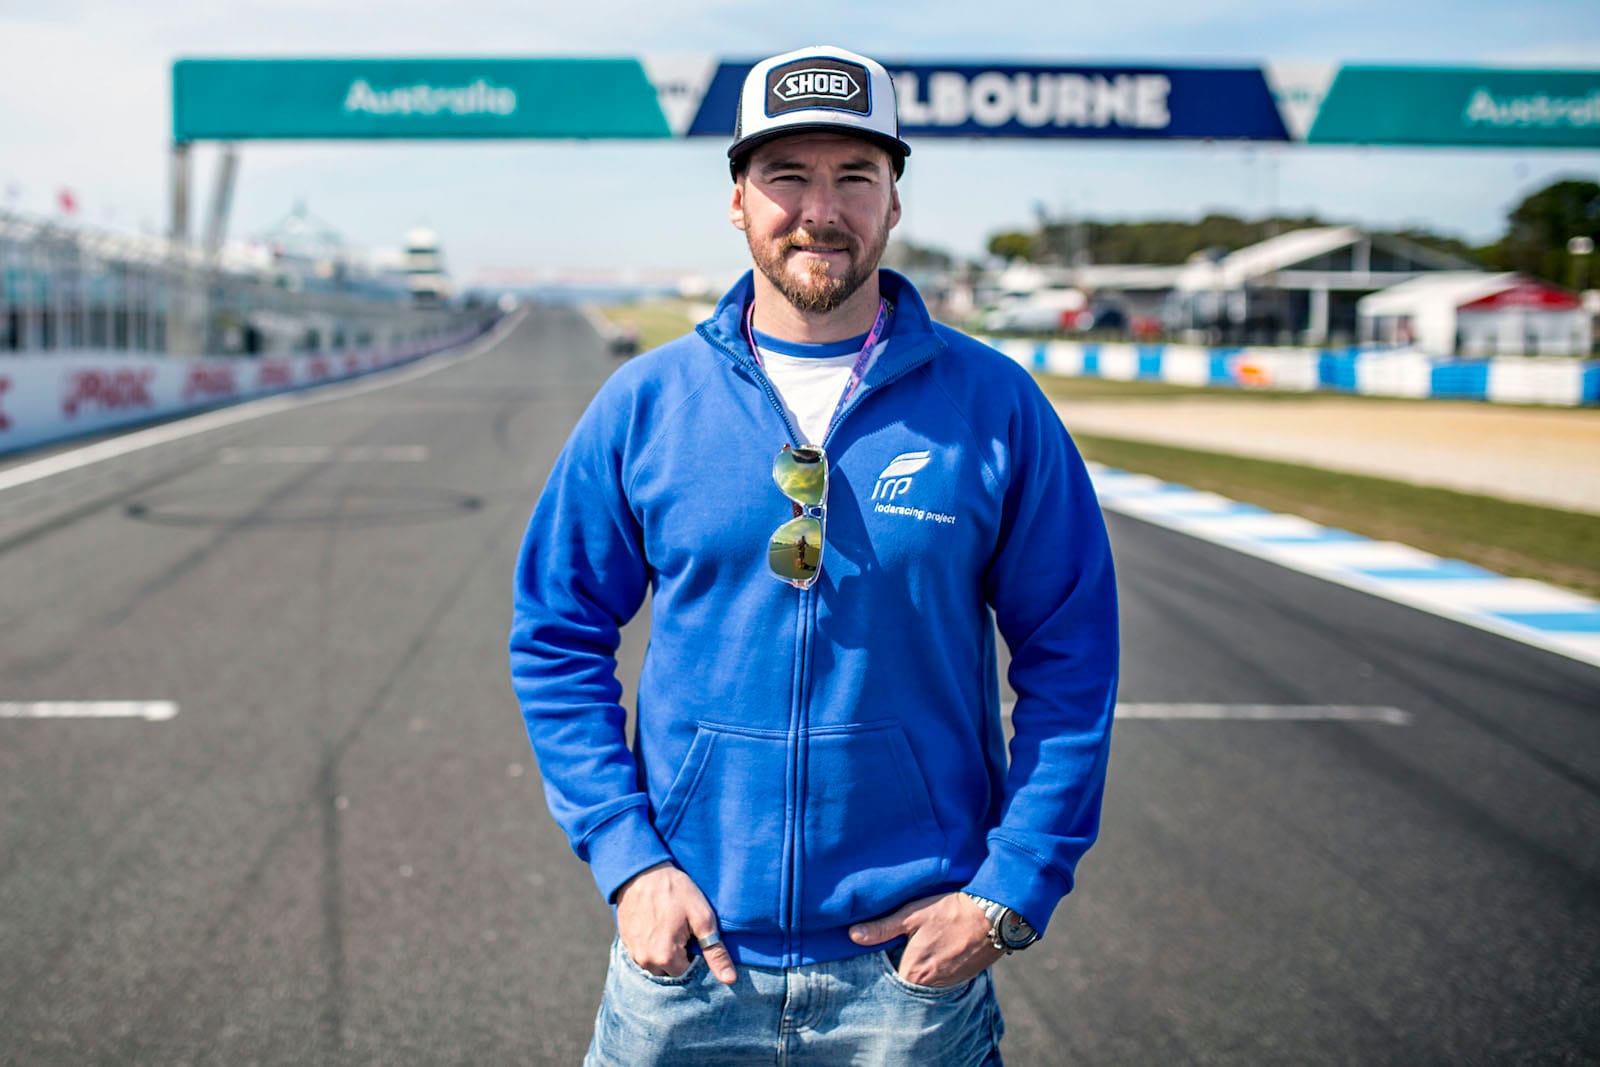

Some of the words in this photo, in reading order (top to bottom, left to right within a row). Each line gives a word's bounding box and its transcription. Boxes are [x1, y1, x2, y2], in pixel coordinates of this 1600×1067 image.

[785, 73, 849, 96] SHOEI
[344, 79, 517, 115] Australia
[925, 511, 956, 524] project
